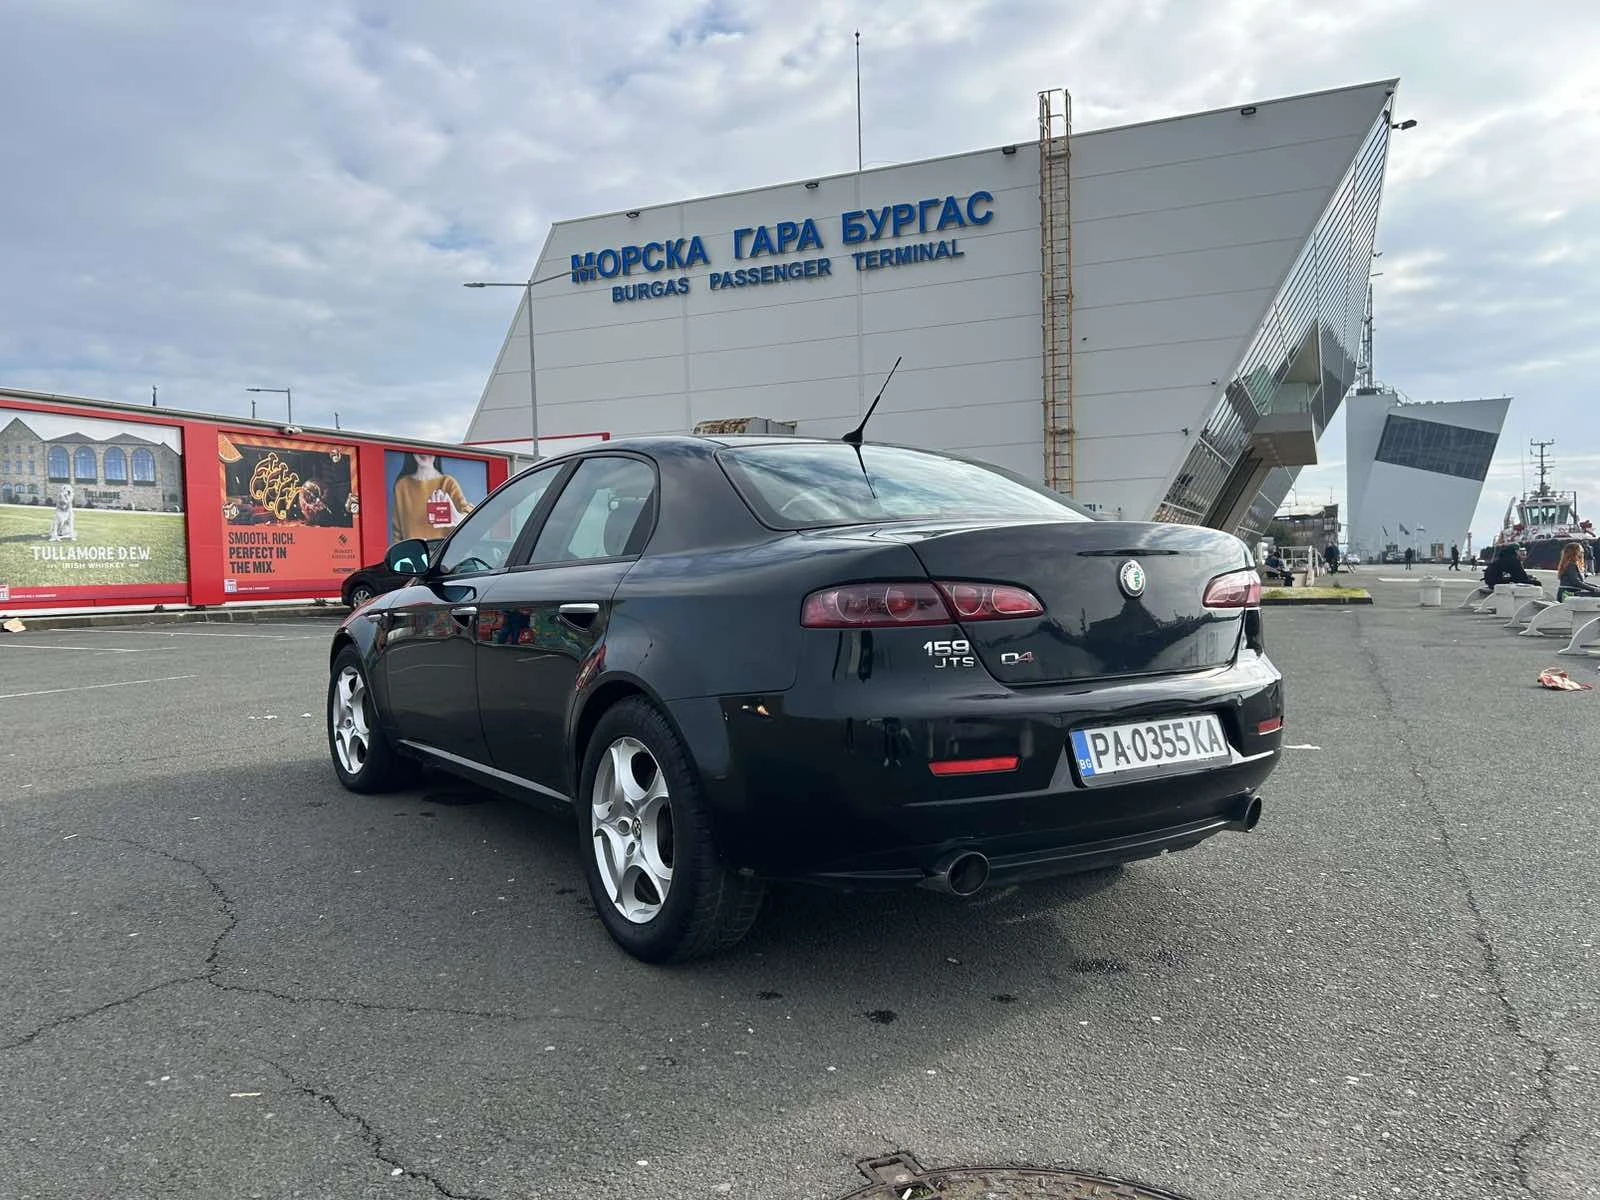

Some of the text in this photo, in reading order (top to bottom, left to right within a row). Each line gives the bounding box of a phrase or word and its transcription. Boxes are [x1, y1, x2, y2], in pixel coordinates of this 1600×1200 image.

[571, 191, 994, 284] МОРСКА ГАРА БУРГАС
[612, 239, 964, 302] BURGAS PASSENGER TERMINAL
[228, 532, 296, 545] SMOOTH. RICH.
[31, 546, 153, 561] TULLAMORE D.E.W.
[229, 547, 287, 560] PERFECT IN
[230, 561, 276, 574] THE MIX.
[923, 640, 970, 656] 159
[934, 656, 975, 669] JTS
[1080, 758, 1092, 770] BG
